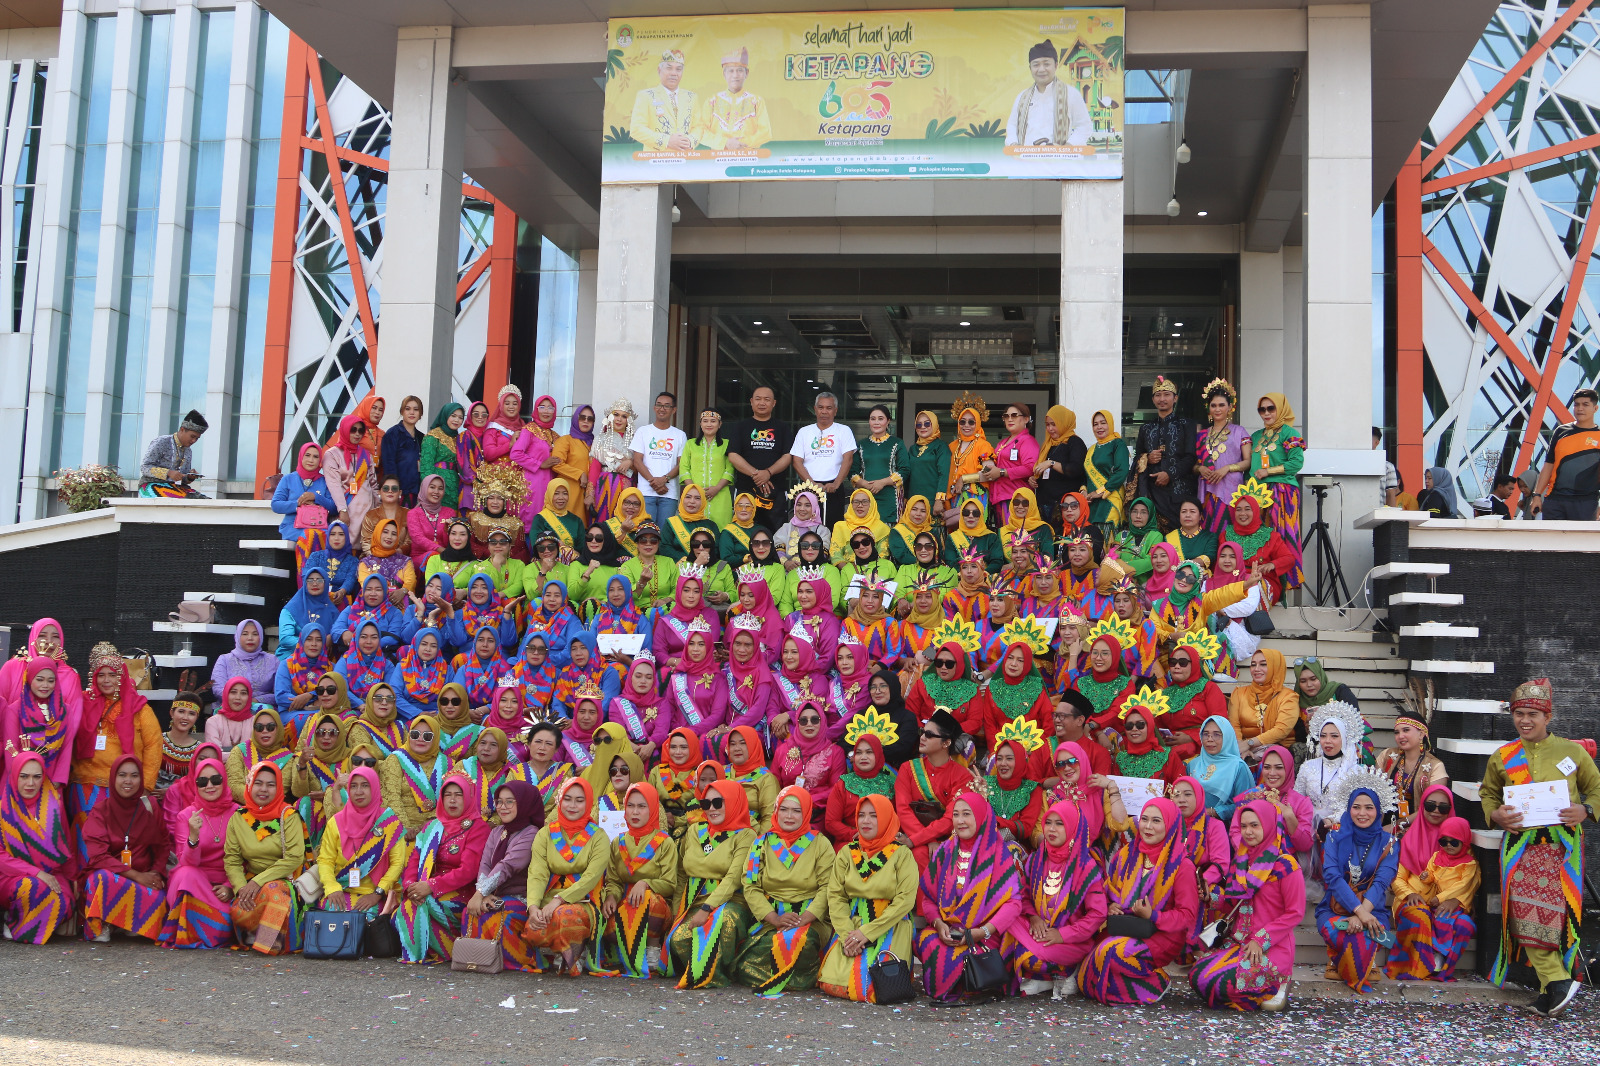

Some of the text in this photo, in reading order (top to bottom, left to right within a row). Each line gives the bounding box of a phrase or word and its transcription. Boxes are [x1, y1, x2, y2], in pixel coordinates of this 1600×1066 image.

[804, 21, 913, 51] selamat hari jadi
[784, 51, 935, 80] KETAPANG
[818, 80, 894, 122] 605
[817, 122, 892, 137] Ketapang
[750, 428, 775, 441] 605
[810, 434, 835, 450] 605
[649, 436, 675, 451] 605
[620, 698, 636, 716] 605
[628, 714, 644, 740] KOTE
[570, 741, 587, 760] 605
[1564, 764, 1573, 772] 16
